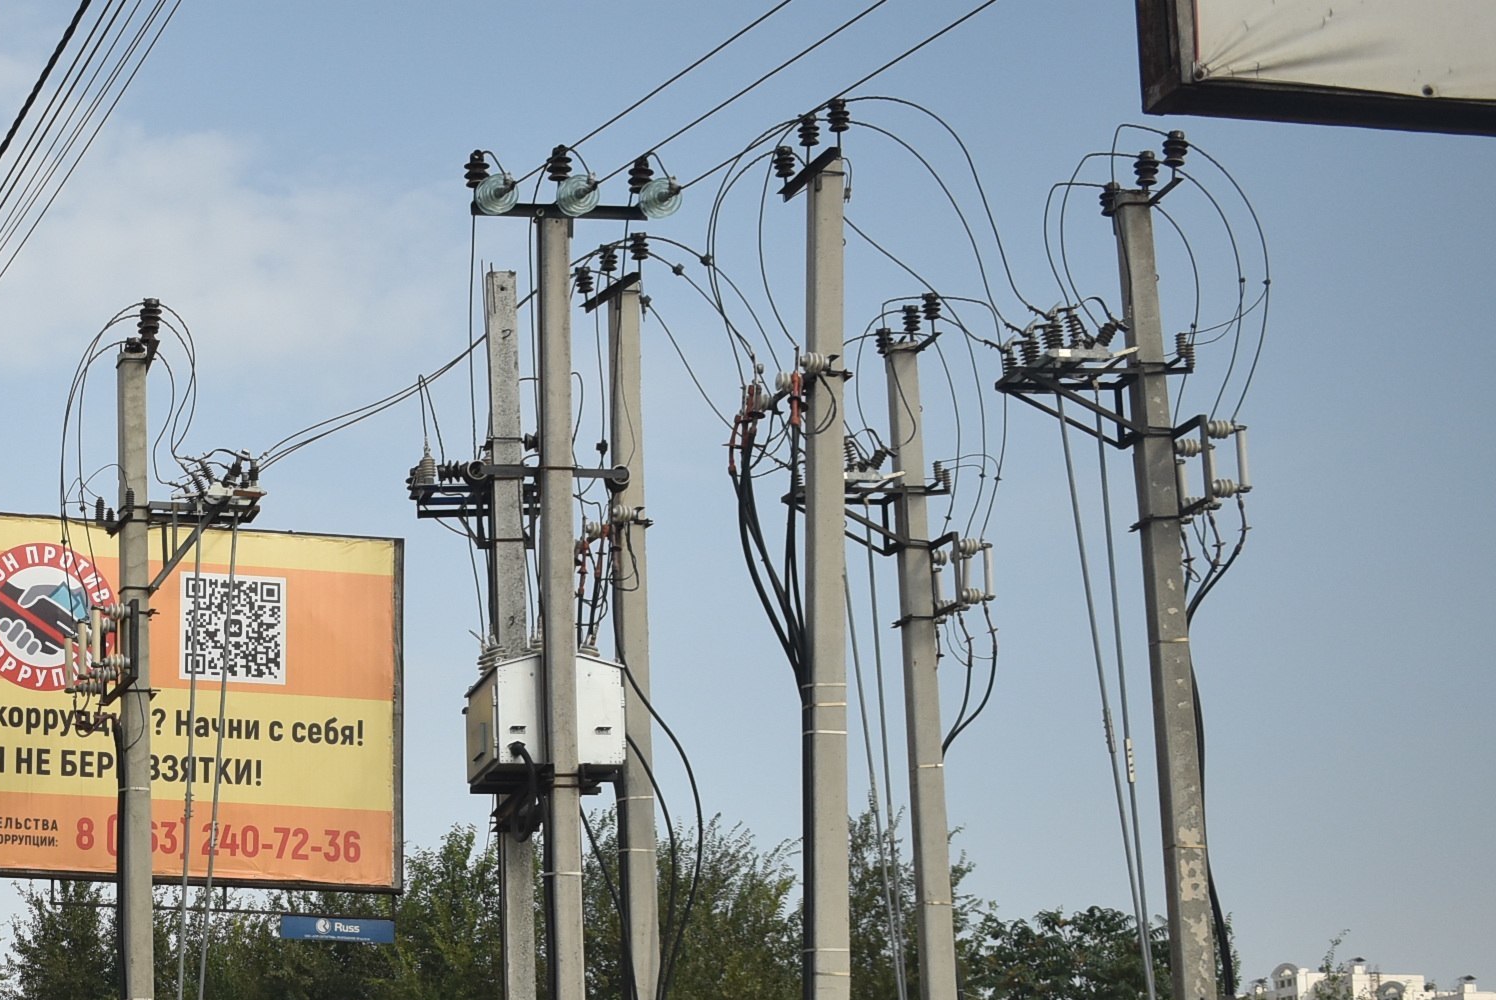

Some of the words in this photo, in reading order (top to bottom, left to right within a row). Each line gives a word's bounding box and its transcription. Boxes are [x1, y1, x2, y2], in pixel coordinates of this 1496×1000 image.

[25, 545, 110, 603] ПРОТИВ
[175, 709, 260, 741] Начни
[268, 720, 284, 742] с
[291, 716, 364, 747] себя!
[15, 747, 51, 776] НЕ
[61, 749, 119, 779] БЕР
[76, 817, 95, 851] 8
[201, 822, 361, 863] 240-72-36
[334, 922, 360, 933] Russ
